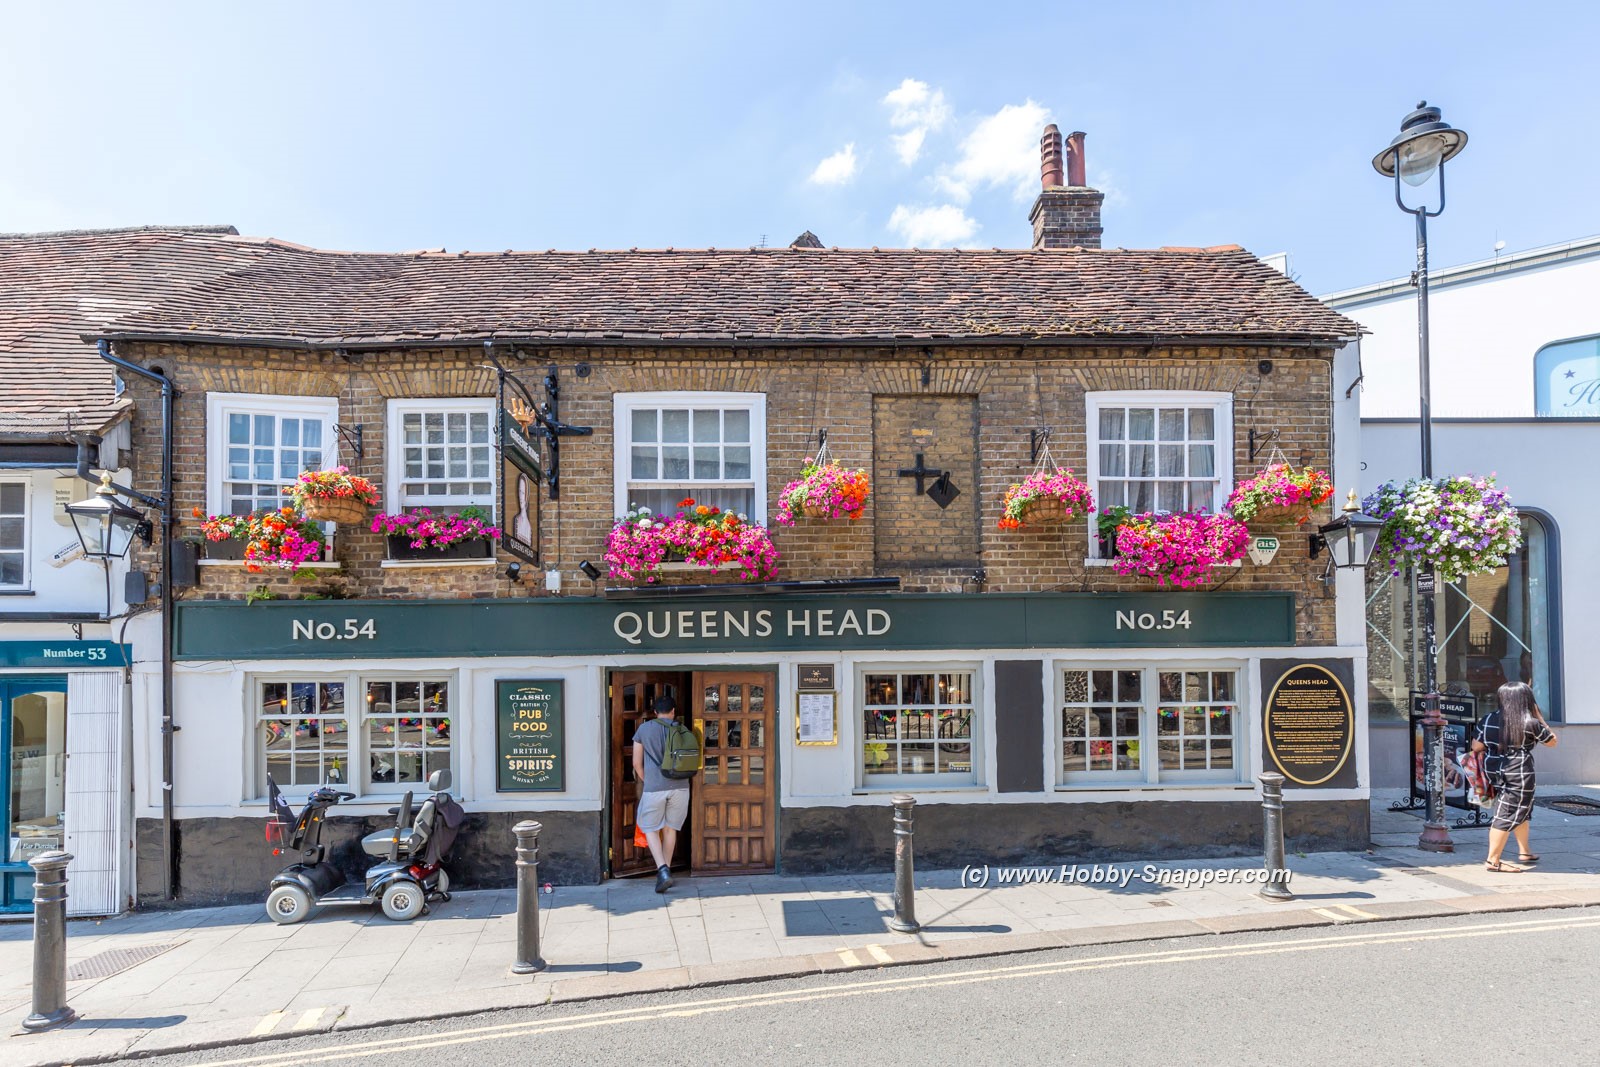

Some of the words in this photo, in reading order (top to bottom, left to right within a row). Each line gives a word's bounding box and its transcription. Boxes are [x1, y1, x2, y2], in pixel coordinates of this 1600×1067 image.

[510, 538, 524, 552] QUEENS
[1115, 609, 1192, 630] No.54
[292, 618, 377, 640] No.54
[613, 610, 773, 644] QUEENS
[787, 609, 892, 636] HEAD
[43, 648, 86, 658] Number
[87, 647, 107, 660] 53
[1446, 704, 1465, 712] HEAD
[519, 709, 542, 719] PUB
[513, 722, 548, 732] FOOD
[508, 760, 554, 770] SPIRITS
[512, 775, 534, 783] WHISKY
[538, 775, 550, 783] GIN
